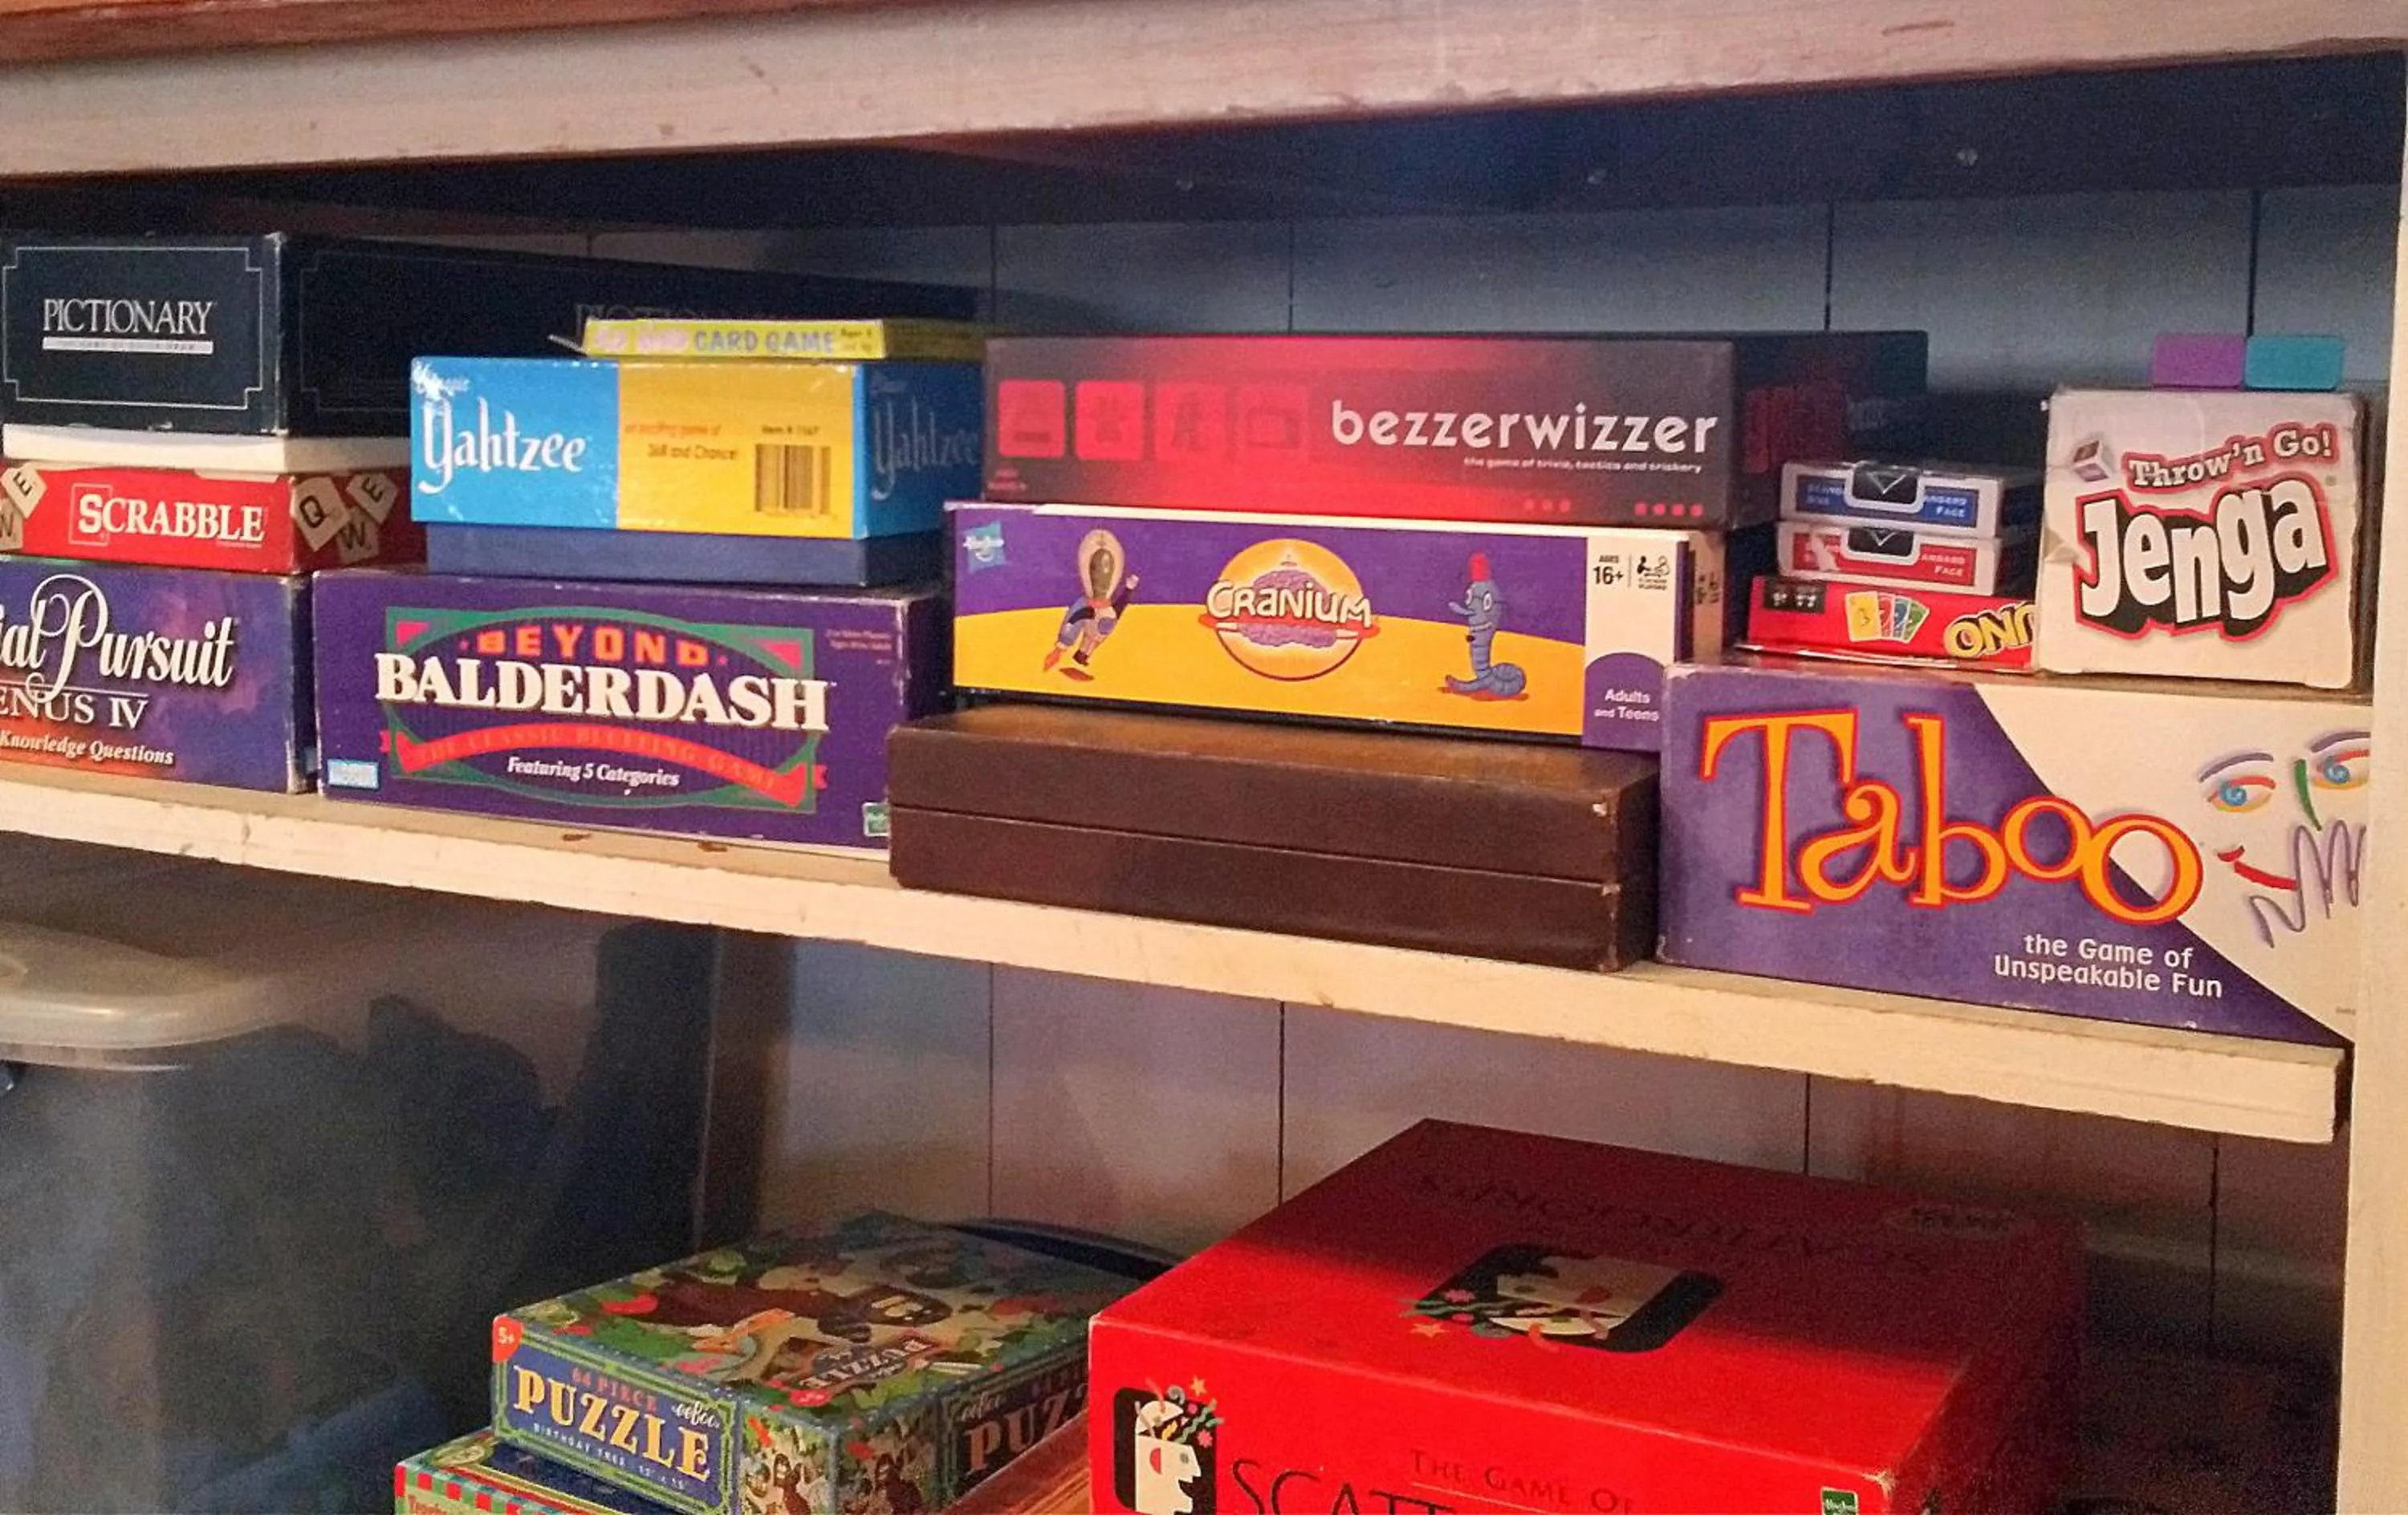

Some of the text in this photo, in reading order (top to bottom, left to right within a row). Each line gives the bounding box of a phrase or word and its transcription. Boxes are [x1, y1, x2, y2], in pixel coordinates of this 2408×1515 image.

[43, 298, 213, 335] PICTIONARY
[694, 330, 759, 351] CARD
[418, 395, 586, 494] Yahtzee
[1332, 400, 1719, 453] bezzerwizzer
[2272, 429, 2333, 458] Go!
[79, 493, 265, 542] SCRABBLE
[2081, 479, 2327, 624] Jenga
[1592, 566, 1624, 585] 16+
[26, 574, 235, 705] Pursuit
[476, 624, 709, 667] BEYOND
[375, 652, 830, 732] BALDERDASH
[1605, 688, 1650, 705] Adults
[108, 697, 149, 729] IV
[1593, 706, 1660, 722] and Teens
[0, 729, 175, 766] Knowledge Questions
[506, 756, 681, 786] Featuring 5 Categories
[1699, 707, 2205, 926] Taboo
[2023, 933, 2194, 969] the Game of
[1994, 954, 2223, 998] Unspeakable Fun
[513, 1364, 711, 1483] PUZZLE
[1484, 1464, 1570, 1505] GAME
